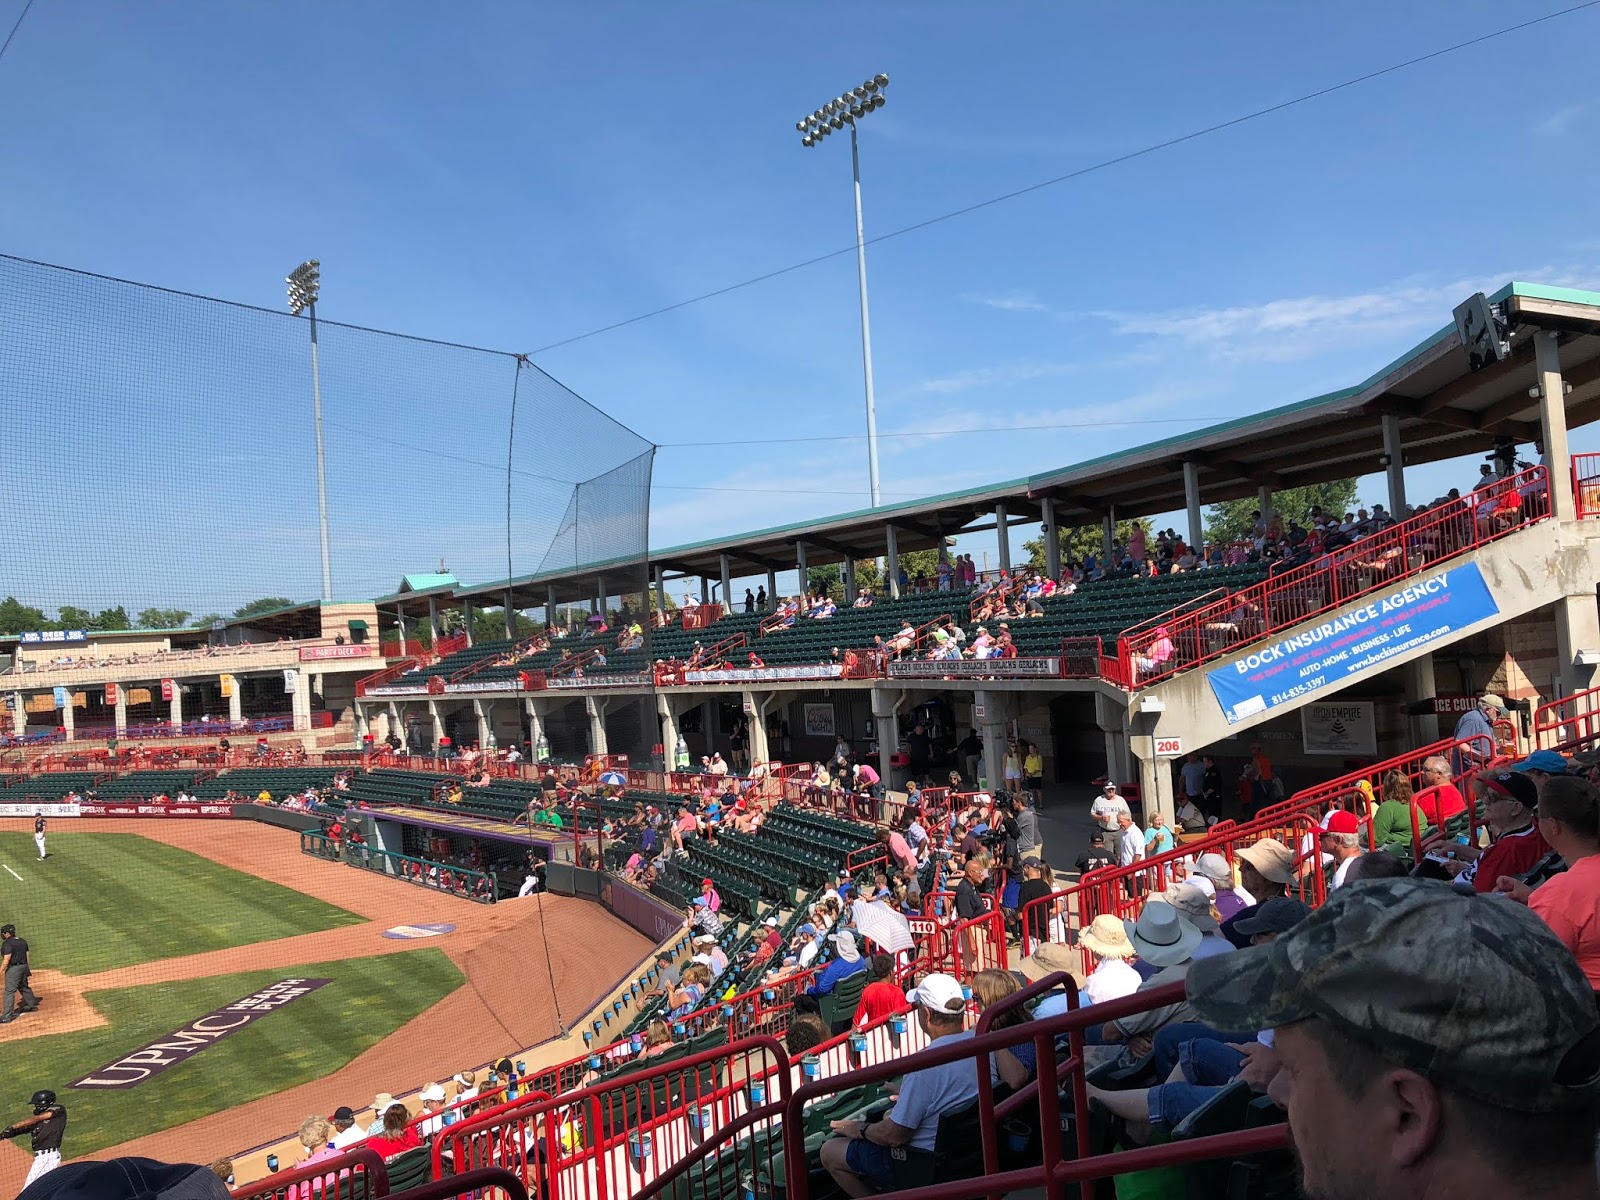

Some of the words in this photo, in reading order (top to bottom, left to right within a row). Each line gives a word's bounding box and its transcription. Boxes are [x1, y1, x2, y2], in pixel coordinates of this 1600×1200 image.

[1235, 644, 1285, 674] BOCK
[1284, 604, 1379, 654] INSURANCE
[1382, 573, 1449, 614] AGENCY
[1310, 645, 1331, 658] SELL
[1395, 610, 1417, 623] HELP
[338, 648, 355, 656] DECK
[1299, 662, 1321, 678] AUTO
[1352, 634, 1390, 655] BUSINESS
[1393, 624, 1412, 638] LIFE
[1347, 625, 1450, 672] www.bockinsurance.com
[1271, 675, 1326, 705] 814-835-3397
[1434, 699, 1450, 713] ICE
[1452, 697, 1477, 711] COLD
[1157, 740, 1180, 752] 206
[1262, 731, 1295, 740] WOMEN
[654, 915, 675, 938] UPMC
[911, 922, 933, 932] 110
[225, 978, 306, 1011] HEALTH
[251, 986, 312, 1011] PLAN
[74, 1015, 251, 1088] UPMC
